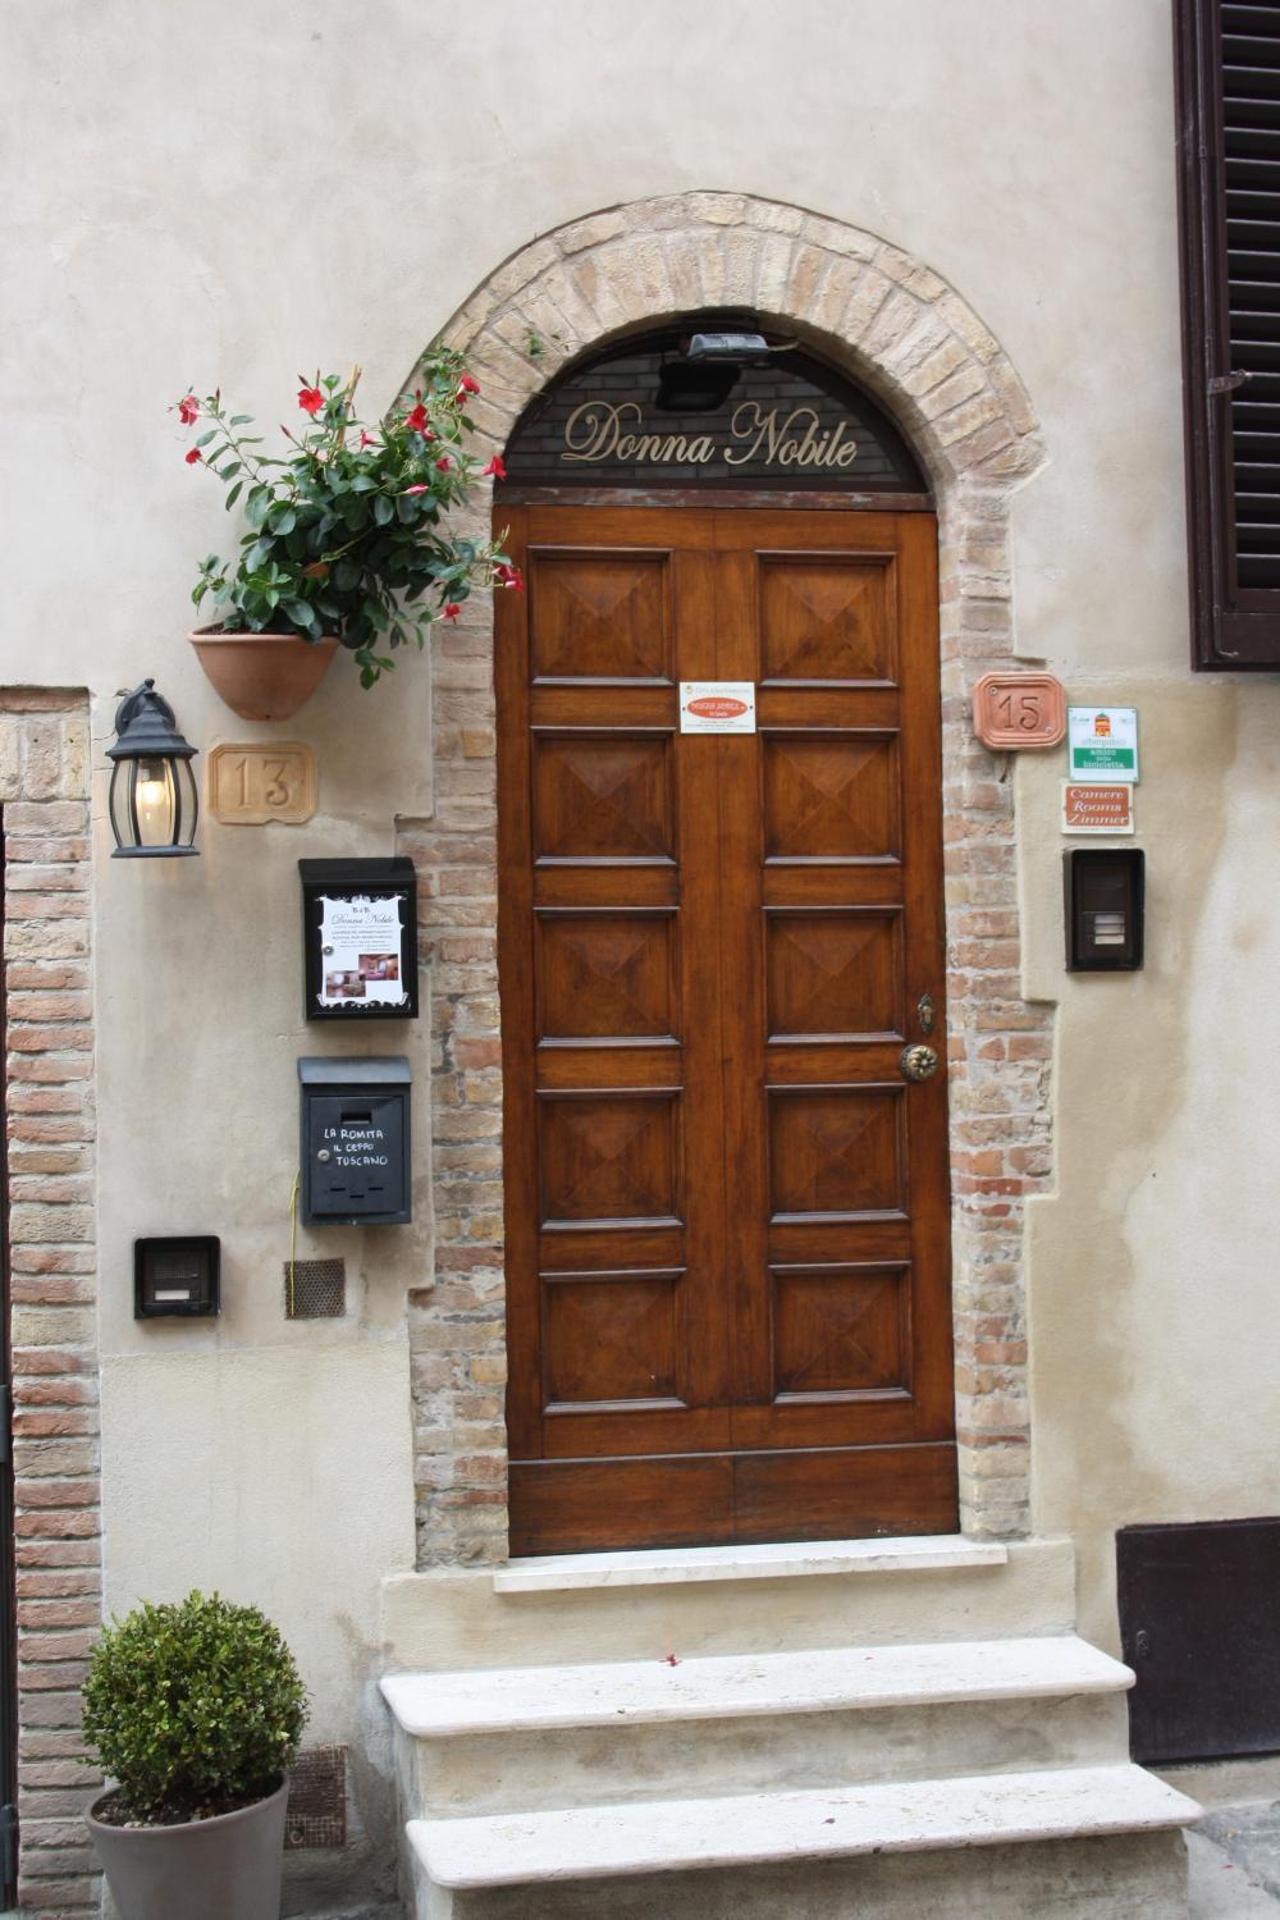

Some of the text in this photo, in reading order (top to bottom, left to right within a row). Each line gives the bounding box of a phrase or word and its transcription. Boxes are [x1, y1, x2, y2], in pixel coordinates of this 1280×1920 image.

[561, 401, 857, 467] Donna Nobile
[998, 695, 1040, 730] 15
[235, 758, 290, 807] 13
[1070, 788, 1124, 800] Camere
[1073, 800, 1122, 812] Rooms
[1067, 813, 1129, 825] Zimmer
[323, 1128, 384, 1140] LA ROMITA
[333, 1144, 342, 1152] IL
